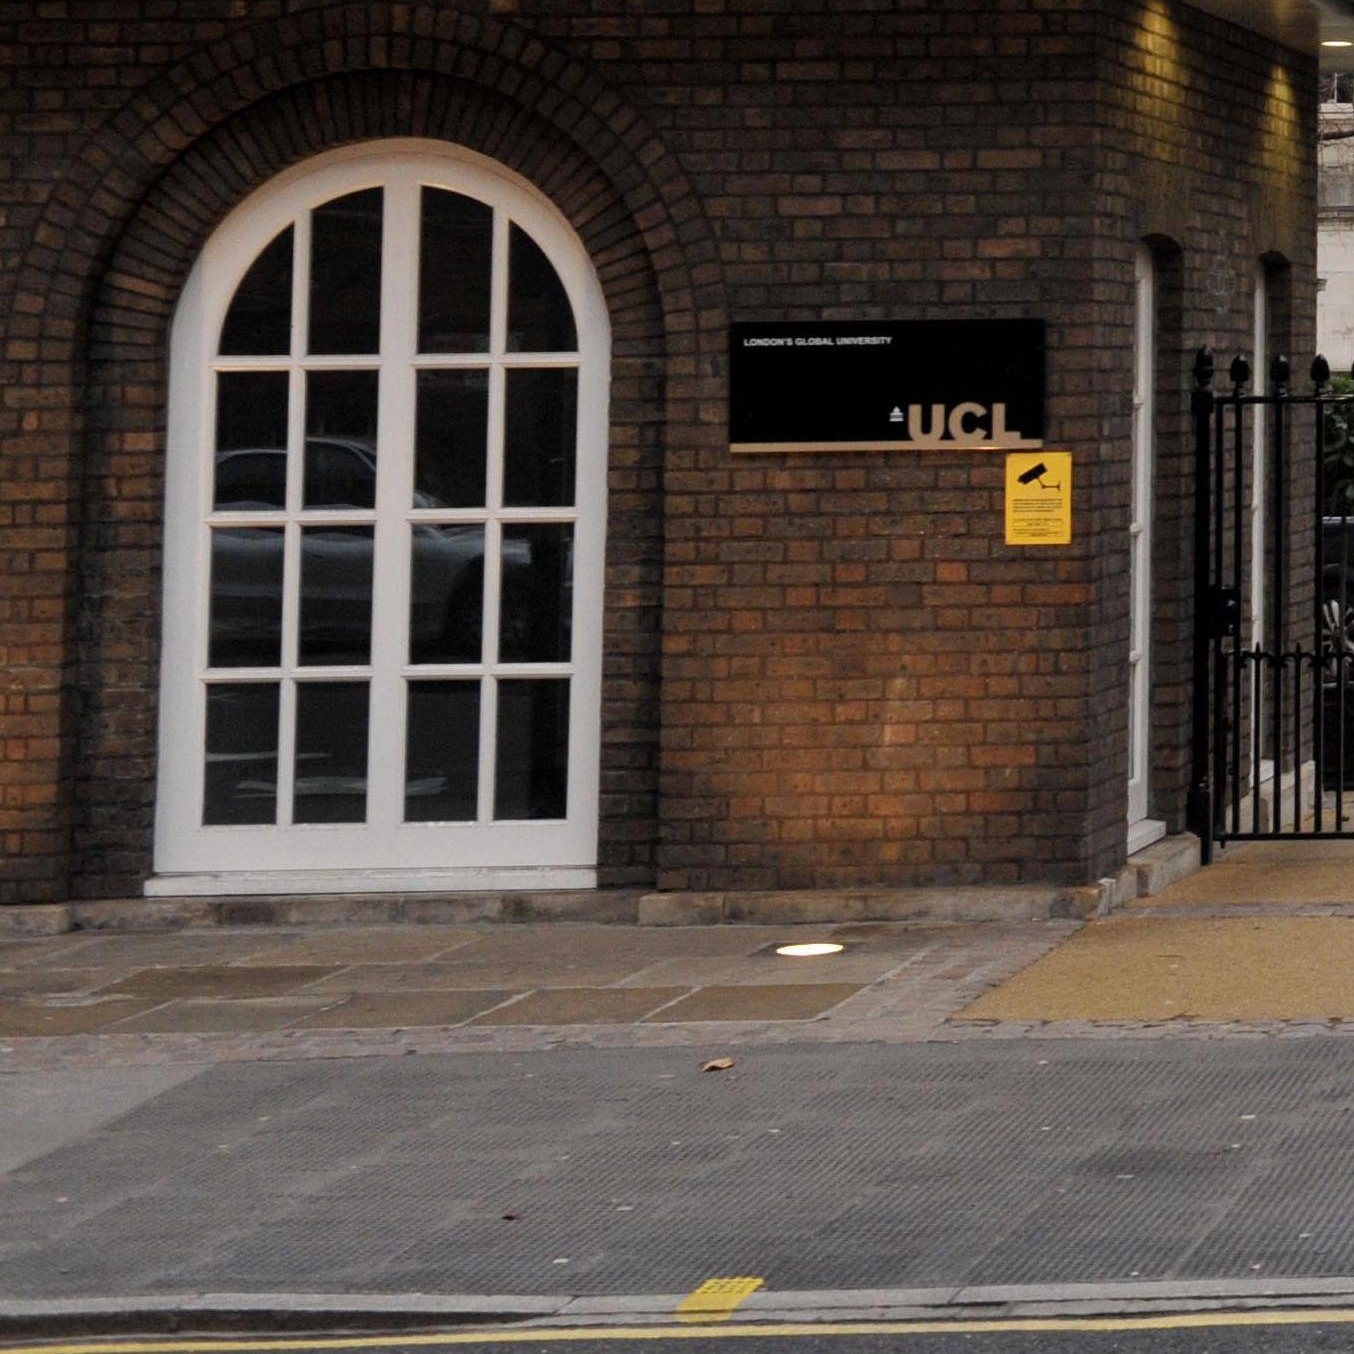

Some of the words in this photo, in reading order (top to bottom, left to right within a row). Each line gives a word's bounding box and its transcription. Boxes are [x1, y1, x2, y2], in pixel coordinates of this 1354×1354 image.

[743, 337, 793, 346] LONDON'S
[795, 337, 834, 346] GLOBAL
[836, 336, 892, 345] UNIVERSITY
[908, 401, 1022, 446] UCL
